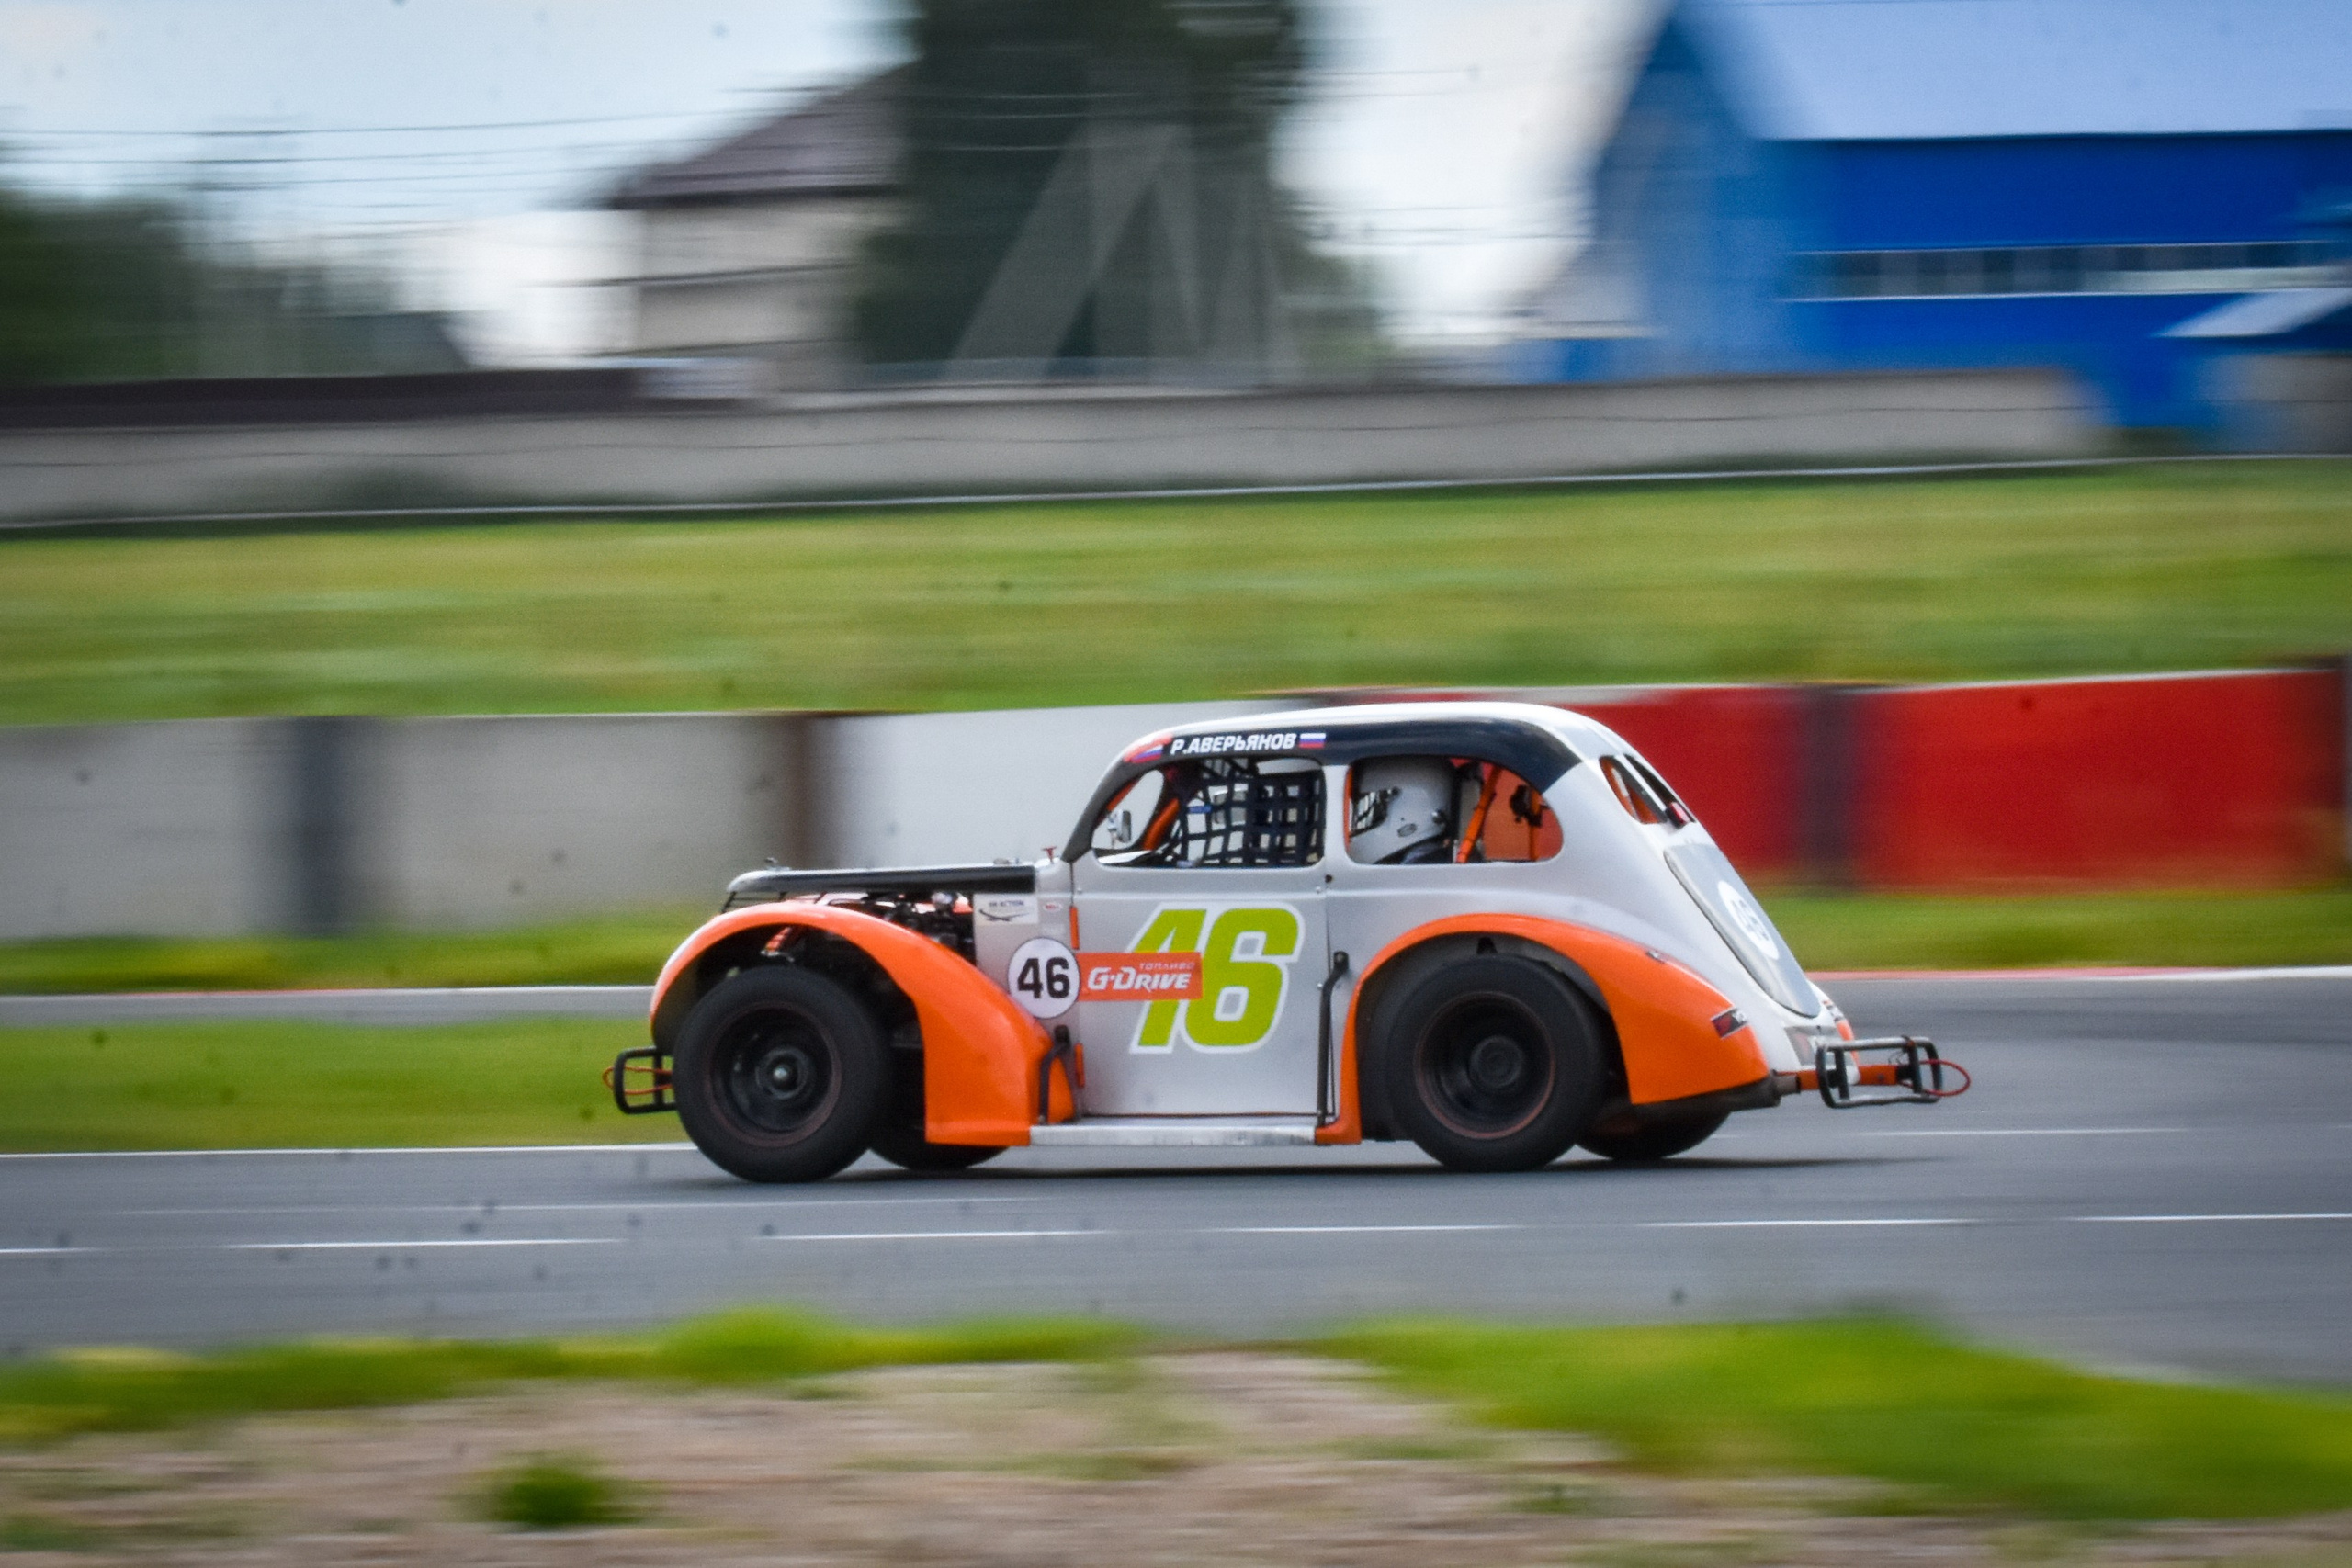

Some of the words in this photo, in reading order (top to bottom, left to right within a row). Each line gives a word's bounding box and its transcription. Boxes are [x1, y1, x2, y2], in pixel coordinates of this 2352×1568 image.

[1170, 733, 1297, 755] Р.АВЕРЬЯНОВ
[1017, 956, 1071, 999] 46
[1125, 902, 1306, 1054] 46
